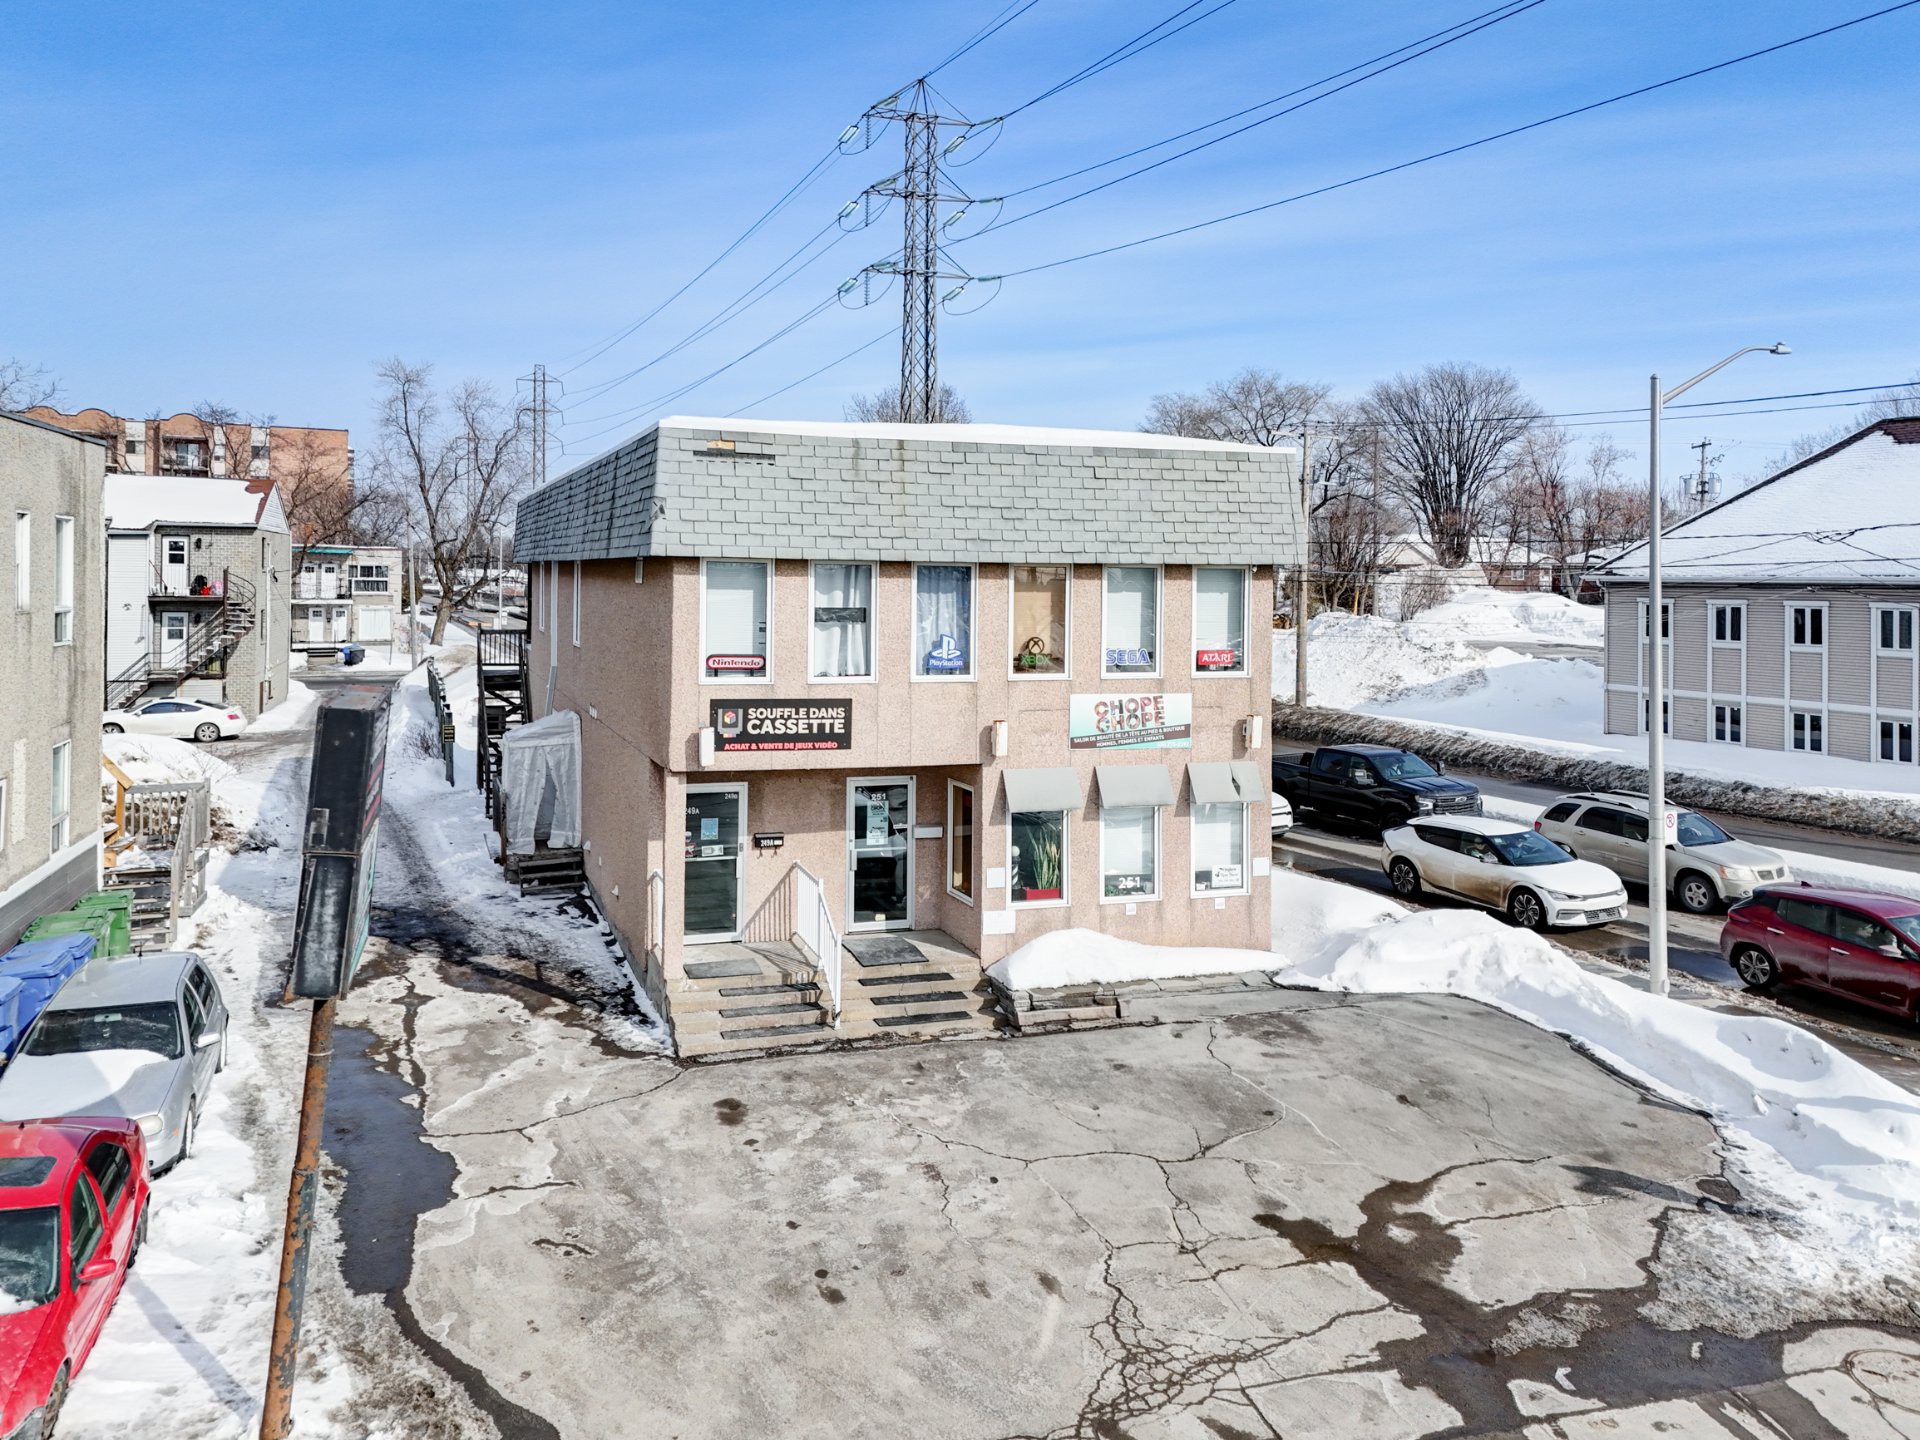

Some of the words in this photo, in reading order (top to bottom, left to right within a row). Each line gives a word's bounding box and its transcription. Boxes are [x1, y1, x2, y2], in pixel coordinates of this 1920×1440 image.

[712, 658, 760, 667] Nintendo
[1021, 654, 1050, 665] XBOX
[1106, 648, 1150, 665] SEGA
[1202, 652, 1232, 662] ATARI
[929, 658, 963, 668] PlayStation
[1094, 695, 1164, 716] CHOPE
[747, 708, 807, 719] SOUFFLE
[809, 707, 845, 719] DANS
[747, 719, 845, 735] CASSETTE
[1096, 711, 1165, 733] CHOPE
[758, 742, 783, 750] VENTE
[783, 742, 795, 750] DE
[795, 742, 814, 750] JEUX
[815, 741, 838, 749] VIDÉO
[1118, 876, 1141, 889] 251
